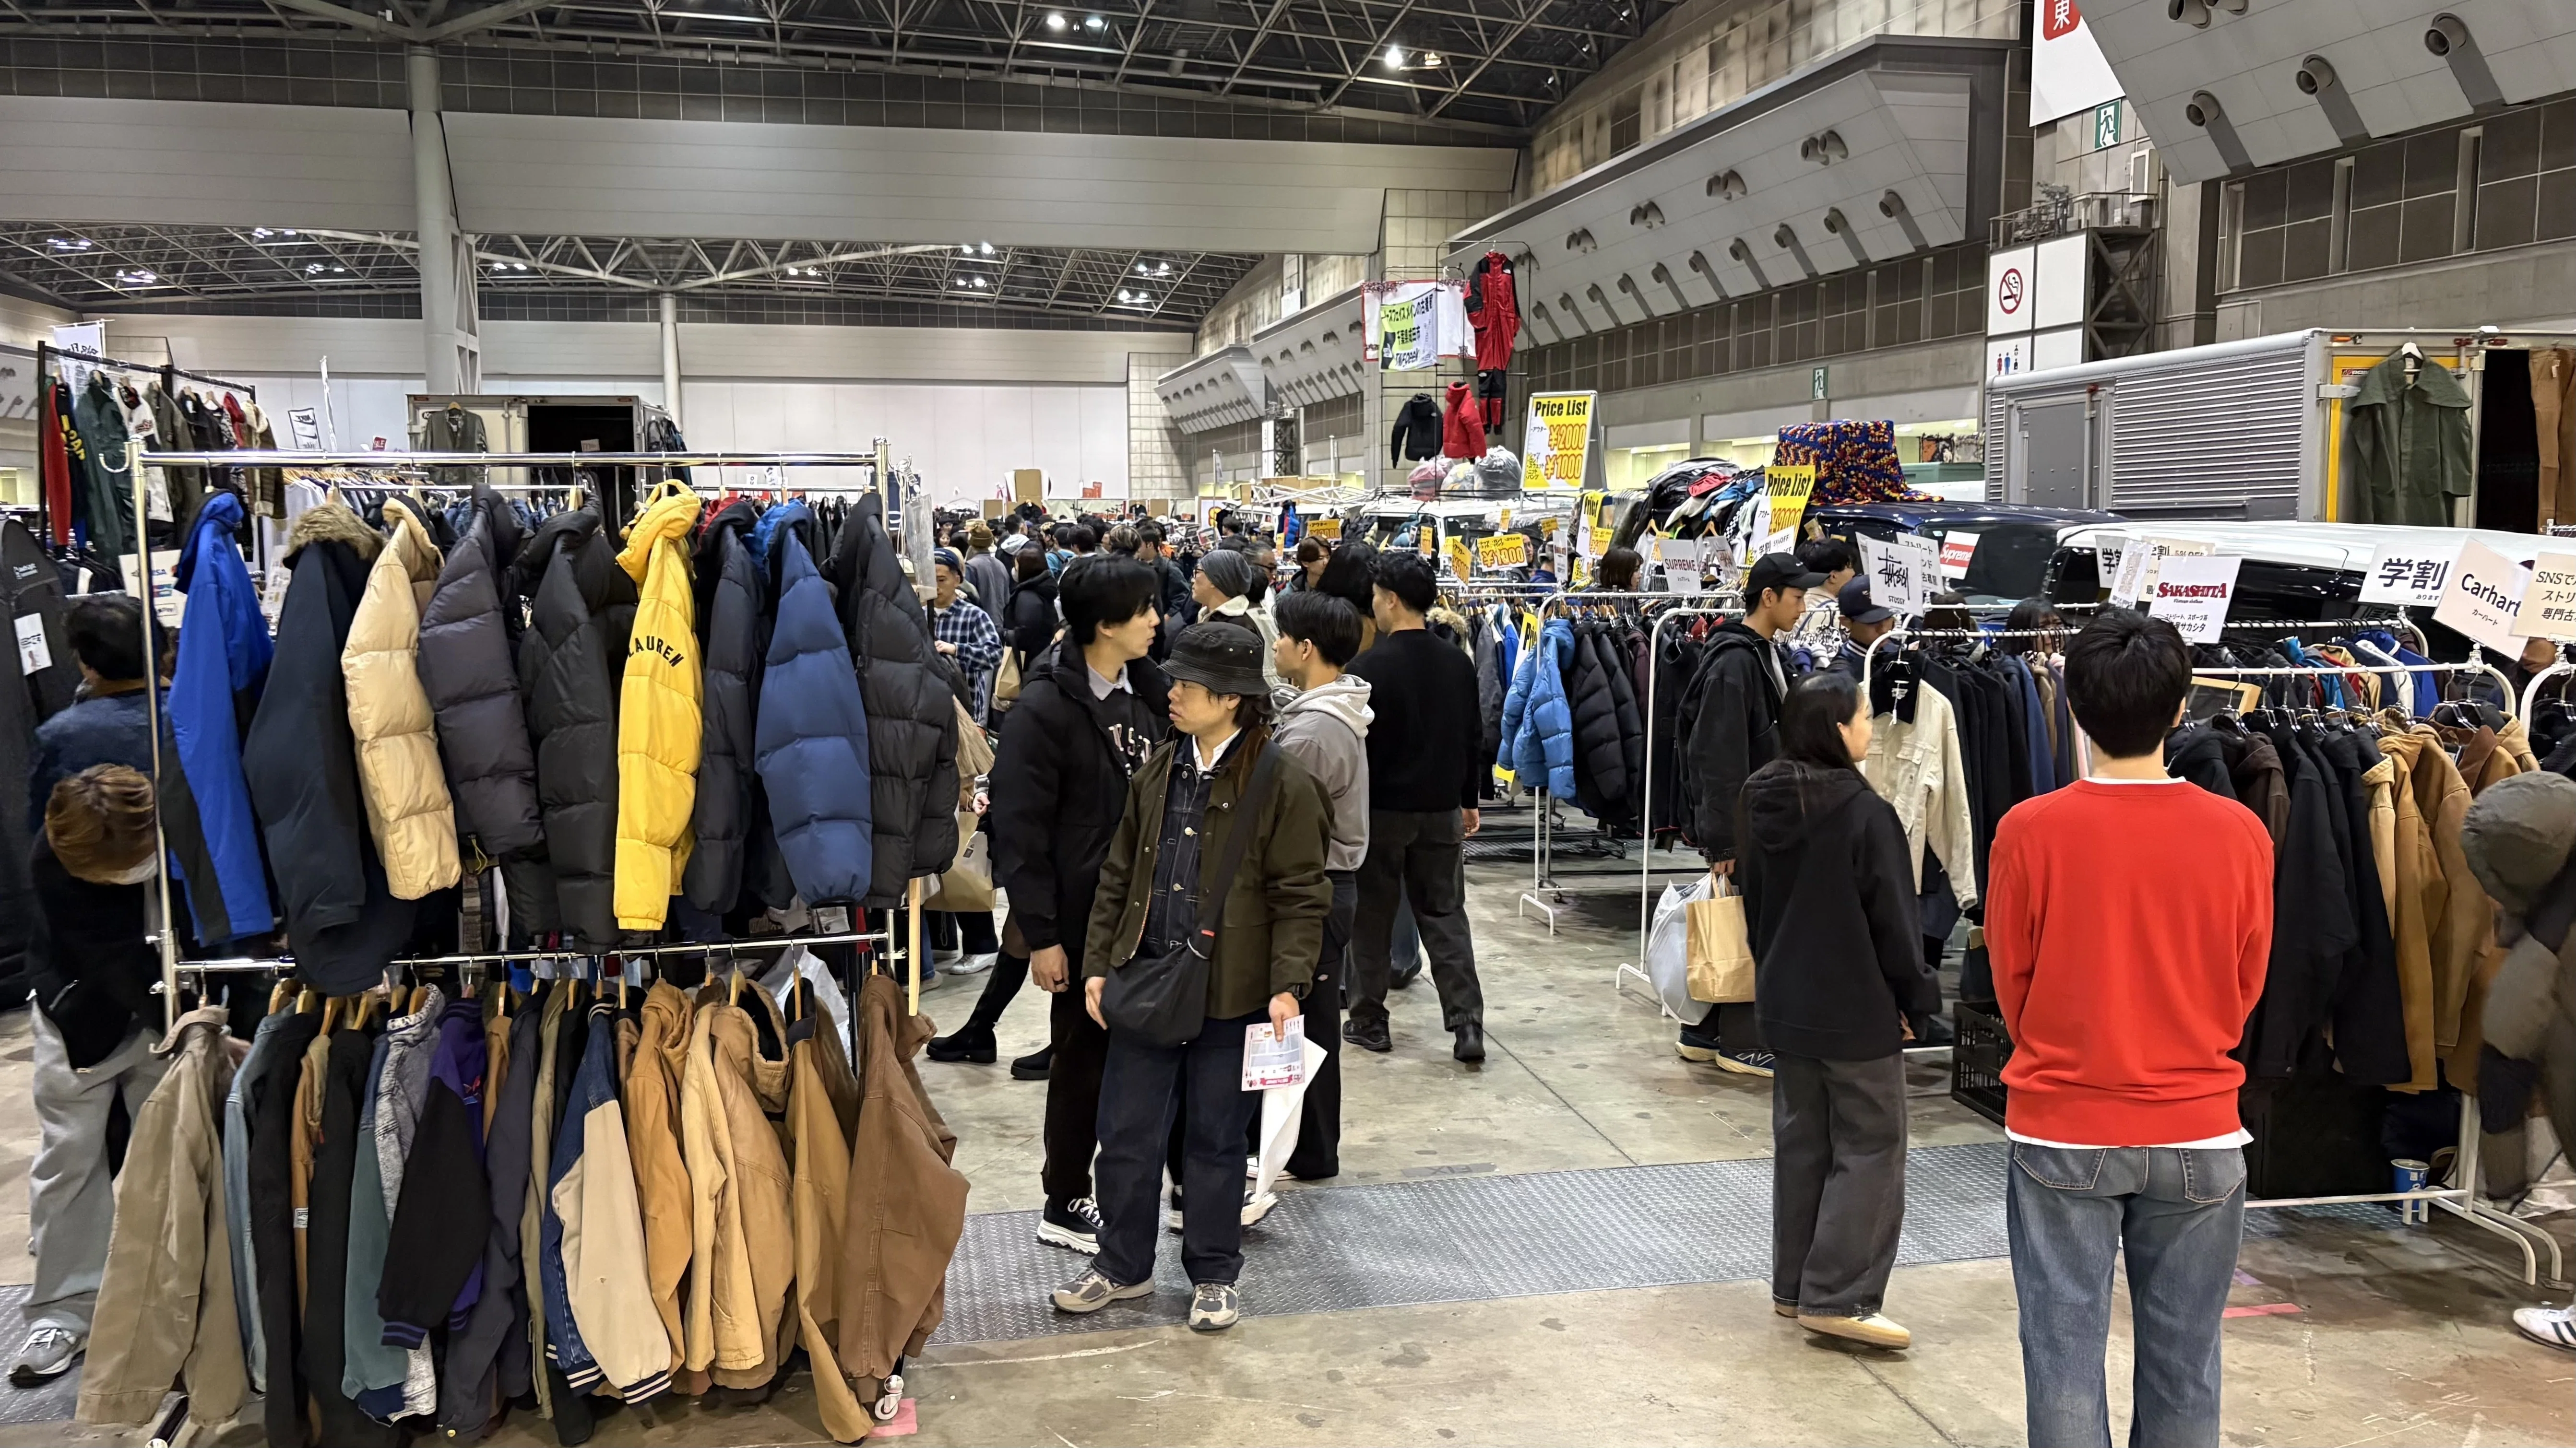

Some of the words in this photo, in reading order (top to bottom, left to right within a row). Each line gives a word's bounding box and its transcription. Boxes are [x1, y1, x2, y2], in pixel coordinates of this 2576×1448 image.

[1535, 400, 1564, 417] Price
[1566, 400, 1587, 416] List
[1548, 424, 1587, 451] ¥2000
[1544, 454, 1583, 480] ¥1000
[1765, 473, 1792, 496] Price
[1790, 473, 1811, 496] List
[1481, 546, 1525, 568] ¥1000
[1940, 544, 1972, 563] Supreme
[1665, 558, 1697, 572] SUPREME
[2378, 558, 2450, 590] 学割
[2535, 571, 2576, 586] SNSで
[2461, 573, 2522, 617] Carhart
[2471, 608, 2498, 626] カーハート
[2541, 608, 2576, 623] 専門古
